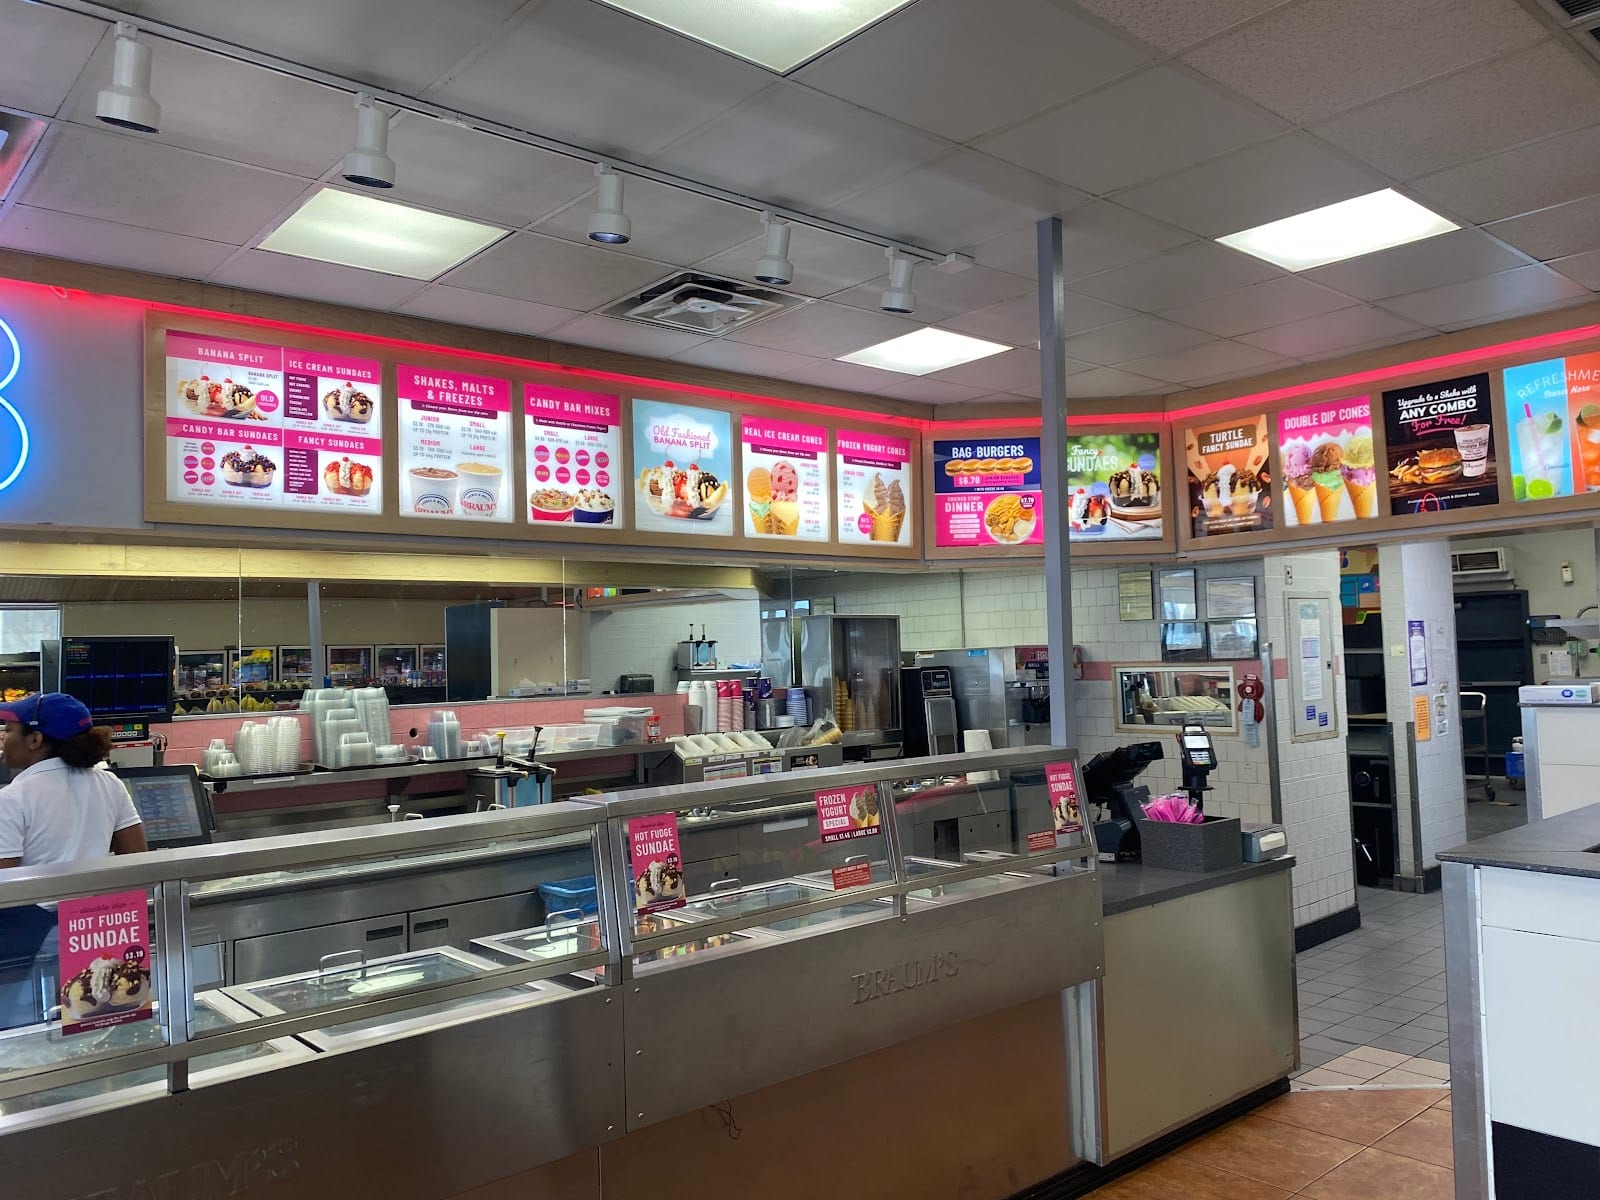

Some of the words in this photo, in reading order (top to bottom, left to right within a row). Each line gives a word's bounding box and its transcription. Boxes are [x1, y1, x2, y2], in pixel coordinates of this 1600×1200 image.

[198, 347, 235, 361] BANANA
[238, 353, 264, 364] SPLIT
[289, 360, 303, 370] ICE
[306, 362, 333, 373] CREAM
[336, 366, 372, 379] SUNDAES
[414, 375, 458, 391] SHAKES,
[462, 382, 495, 396] MALTS
[260, 395, 275, 403] OLD
[427, 390, 434, 400] &
[439, 391, 483, 406] FREEZES
[1397, 394, 1425, 408] Upgrade
[1426, 393, 1433, 401] to
[1440, 388, 1460, 398] Shake
[1461, 385, 1477, 395] with
[530, 397, 560, 410] CANDY
[564, 402, 581, 412] BAR
[585, 405, 610, 416] MIXES
[1400, 407, 1428, 421] ANY
[1429, 398, 1476, 414] COMBO
[1284, 414, 1319, 430] DOUBLE
[1321, 410, 1336, 424] DIP
[1339, 404, 1370, 421] CONES
[1411, 418, 1433, 432] For
[1435, 414, 1467, 428] Free!
[182, 424, 213, 435] CANDY
[217, 426, 235, 437] BAR
[238, 429, 279, 441] SUNDAES
[653, 425, 670, 437] Old
[672, 428, 711, 442] Fashioned
[744, 427, 762, 438] REAL
[764, 430, 776, 439] ICE
[778, 431, 800, 443] CREAM
[802, 435, 823, 445] CONES
[1210, 428, 1244, 443] TURTLE
[298, 436, 325, 446] FANCY
[328, 438, 365, 450] SUNDAES
[654, 436, 688, 447] BANANA
[689, 441, 710, 449] SPLIT
[838, 440, 861, 450] FROZEN
[863, 444, 885, 453] YOGURT
[887, 447, 906, 456] CONES
[1202, 444, 1224, 454] FANCY
[1226, 438, 1254, 450] SUNDAE
[952, 447, 972, 458] BAG
[977, 445, 1024, 458] BURGERS
[1071, 445, 1098, 459] Fancy
[945, 502, 984, 513] DINNER
[1058, 772, 1071, 780] FUDGE
[1051, 781, 1074, 792] SUNDAE
[819, 793, 846, 806] FROZEN
[820, 805, 847, 818] YOGURT
[825, 818, 847, 828] SPECIAL
[635, 831, 648, 842] HOT
[651, 828, 672, 840] FUDGE
[854, 830, 866, 838] LARGE
[635, 839, 676, 857] SUNDAE
[112, 902, 126, 910] dip
[69, 917, 94, 932] HOT
[98, 910, 138, 928] FUDGE
[68, 926, 140, 953] SUNDAE
[852, 951, 960, 1006] BRAUM'S
